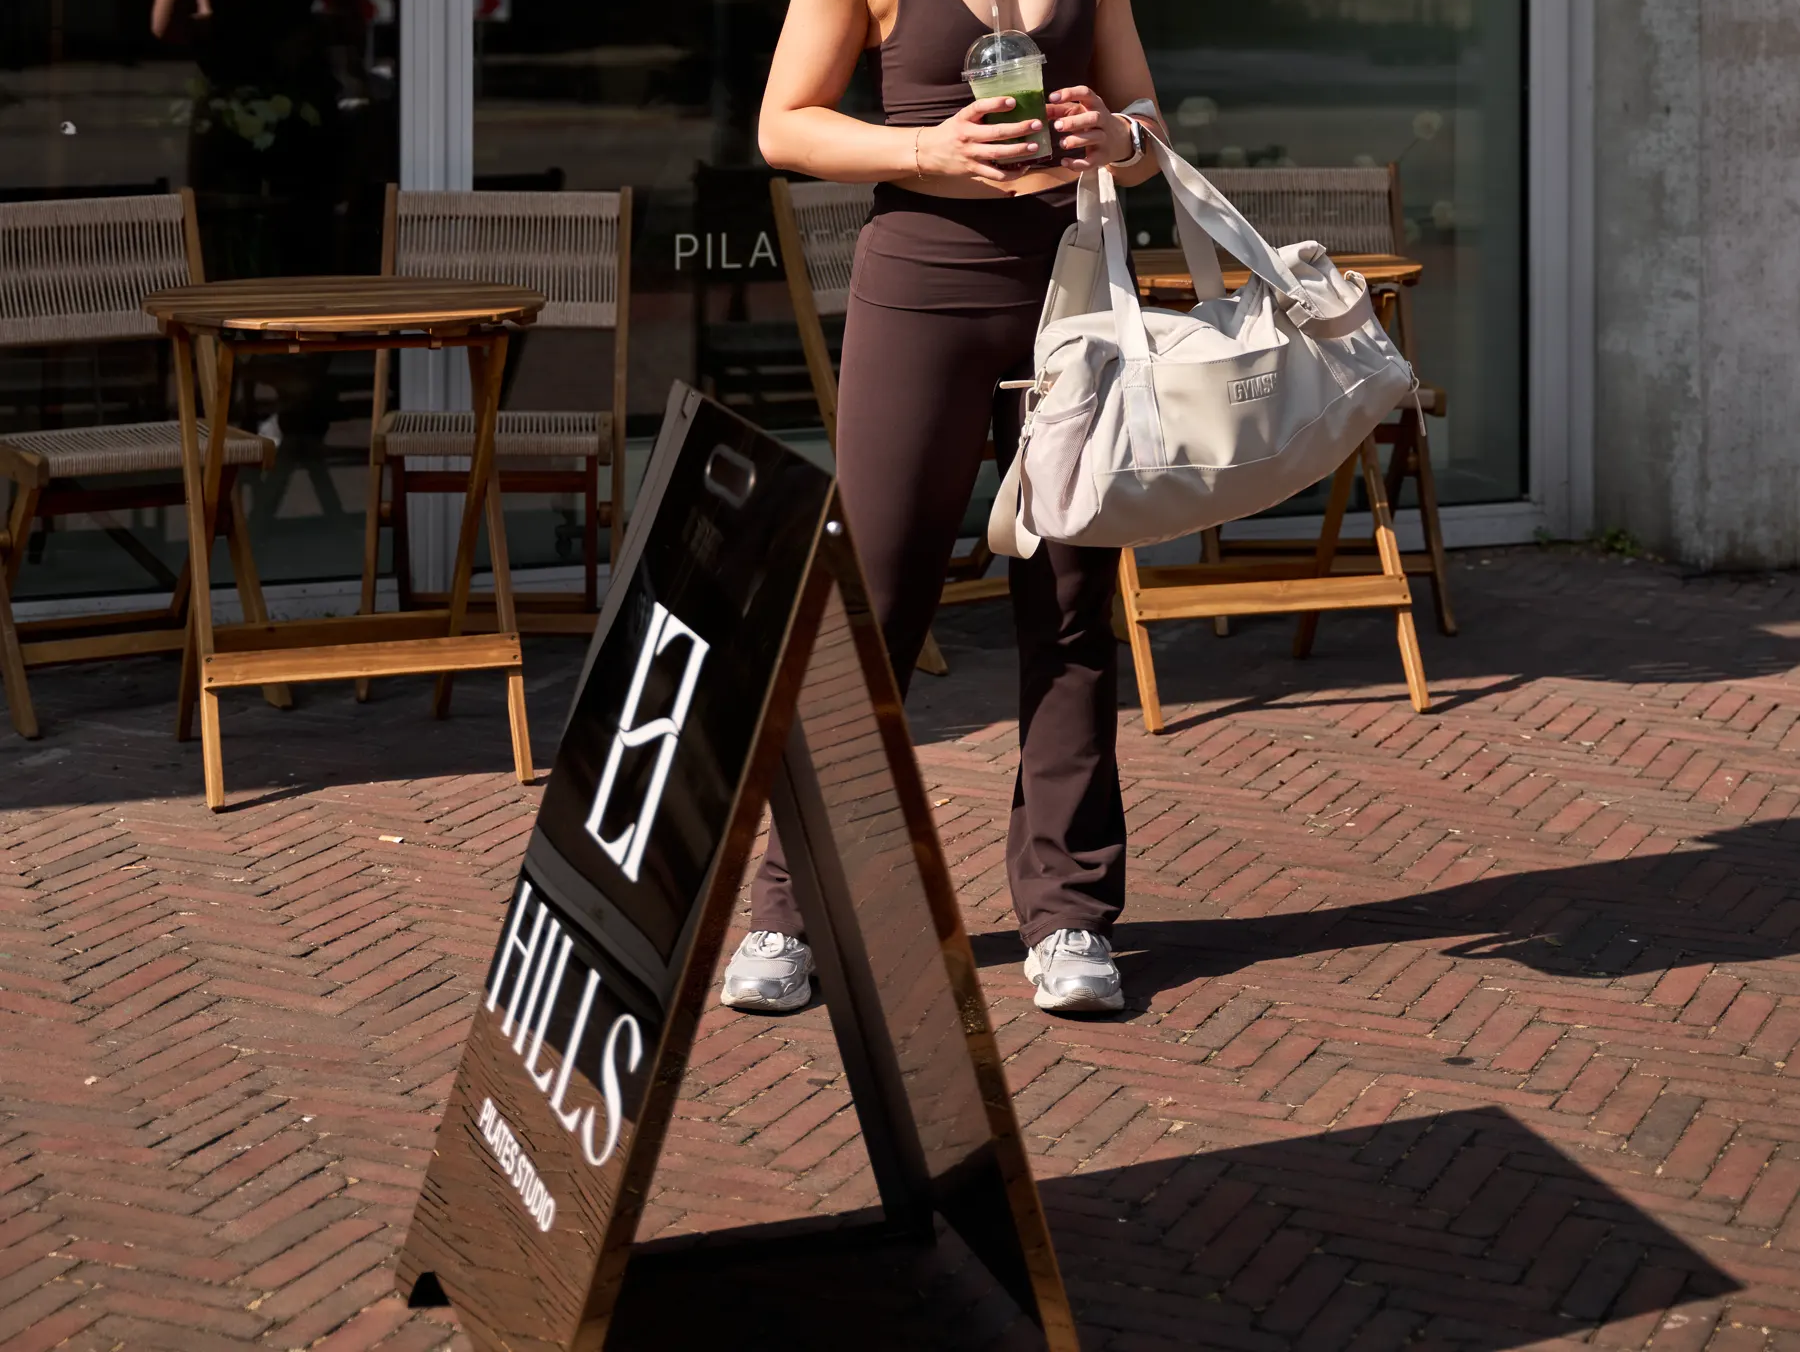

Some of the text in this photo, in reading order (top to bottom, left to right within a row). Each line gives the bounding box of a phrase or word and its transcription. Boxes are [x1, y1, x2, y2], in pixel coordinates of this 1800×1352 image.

[485, 880, 644, 1168] HILLS
[478, 1096, 557, 1233] PILATES STUDIO
